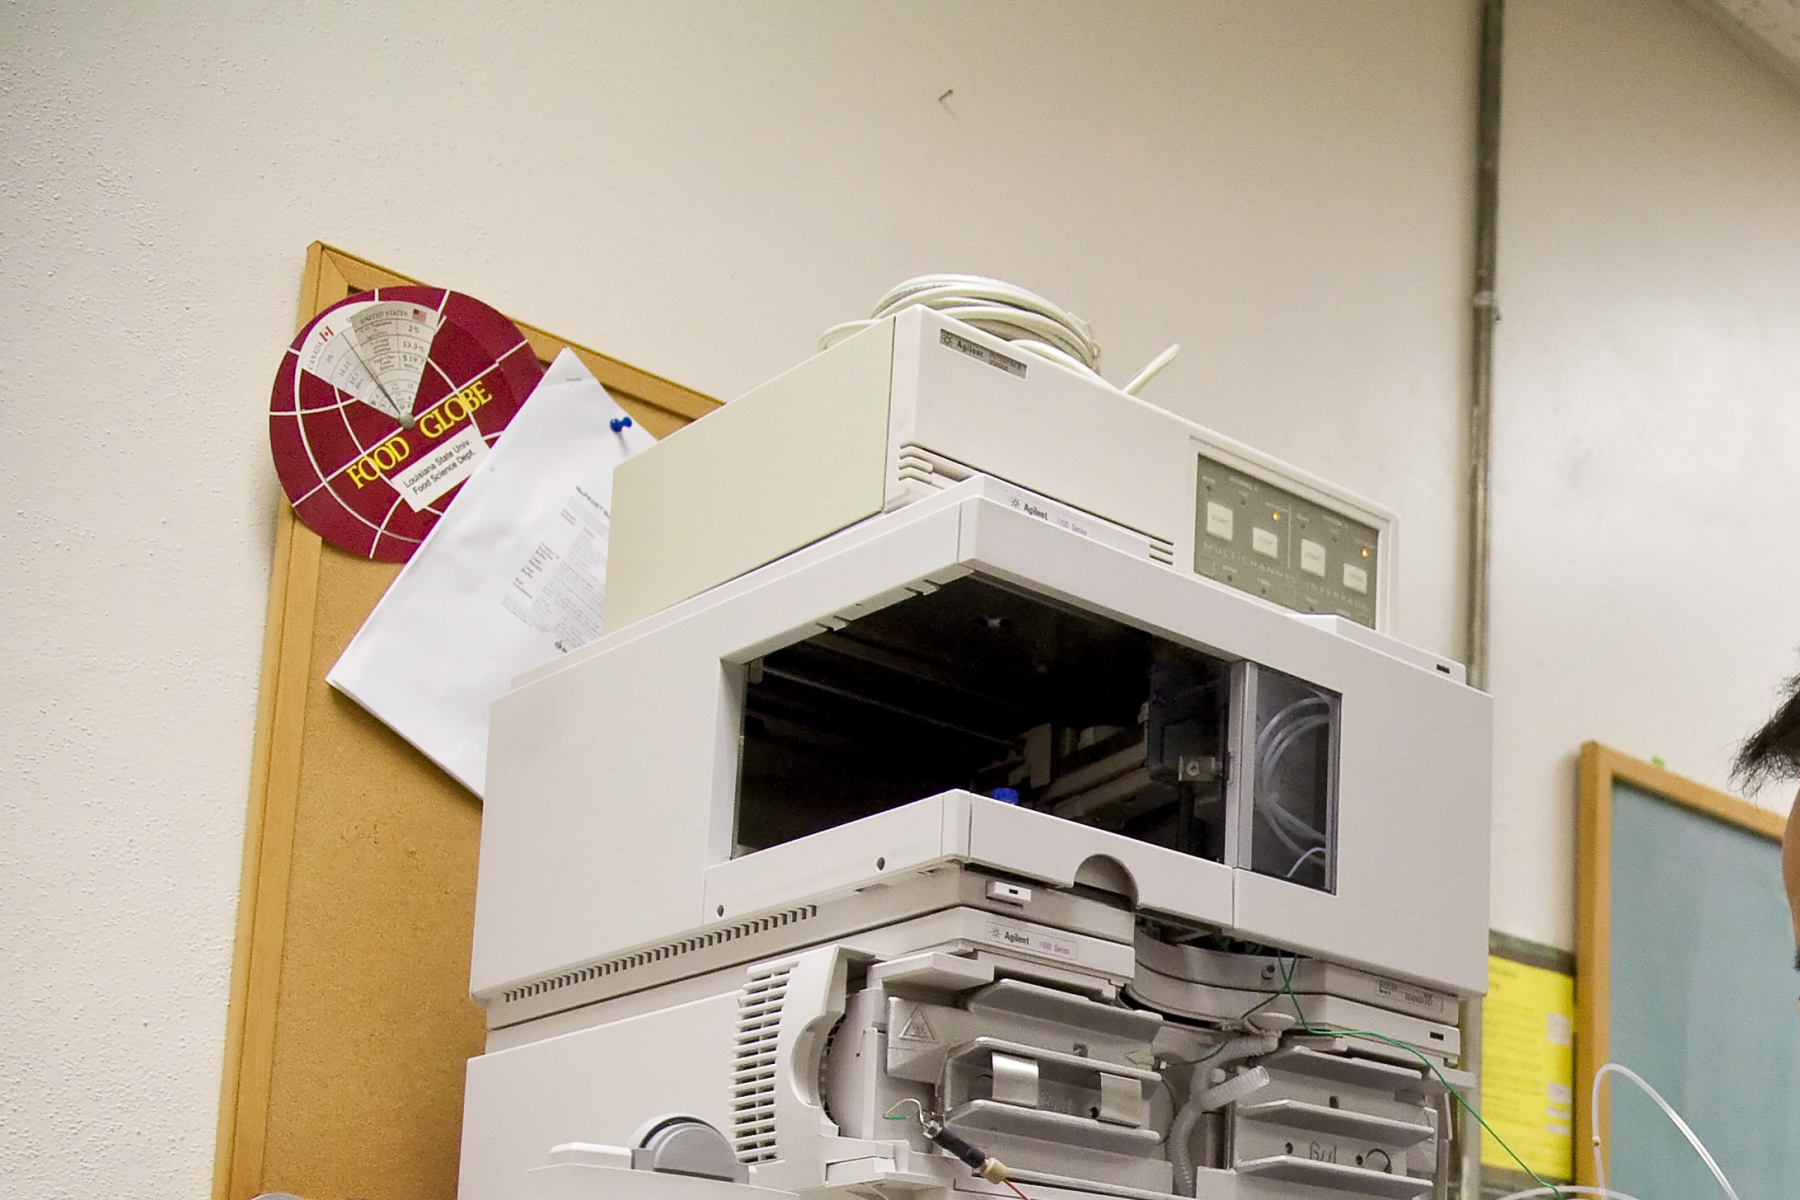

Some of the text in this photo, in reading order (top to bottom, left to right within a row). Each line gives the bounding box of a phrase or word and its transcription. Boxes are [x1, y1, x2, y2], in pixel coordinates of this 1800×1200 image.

[307, 341, 323, 370] CANADA
[346, 380, 493, 490] FOOD GLOBE
[403, 461, 437, 489] Louisiana
[434, 448, 455, 466] State
[411, 475, 432, 495] Food
[431, 460, 459, 483] Science
[1024, 503, 1048, 520] Agilent
[1004, 931, 1029, 945] Agilent
